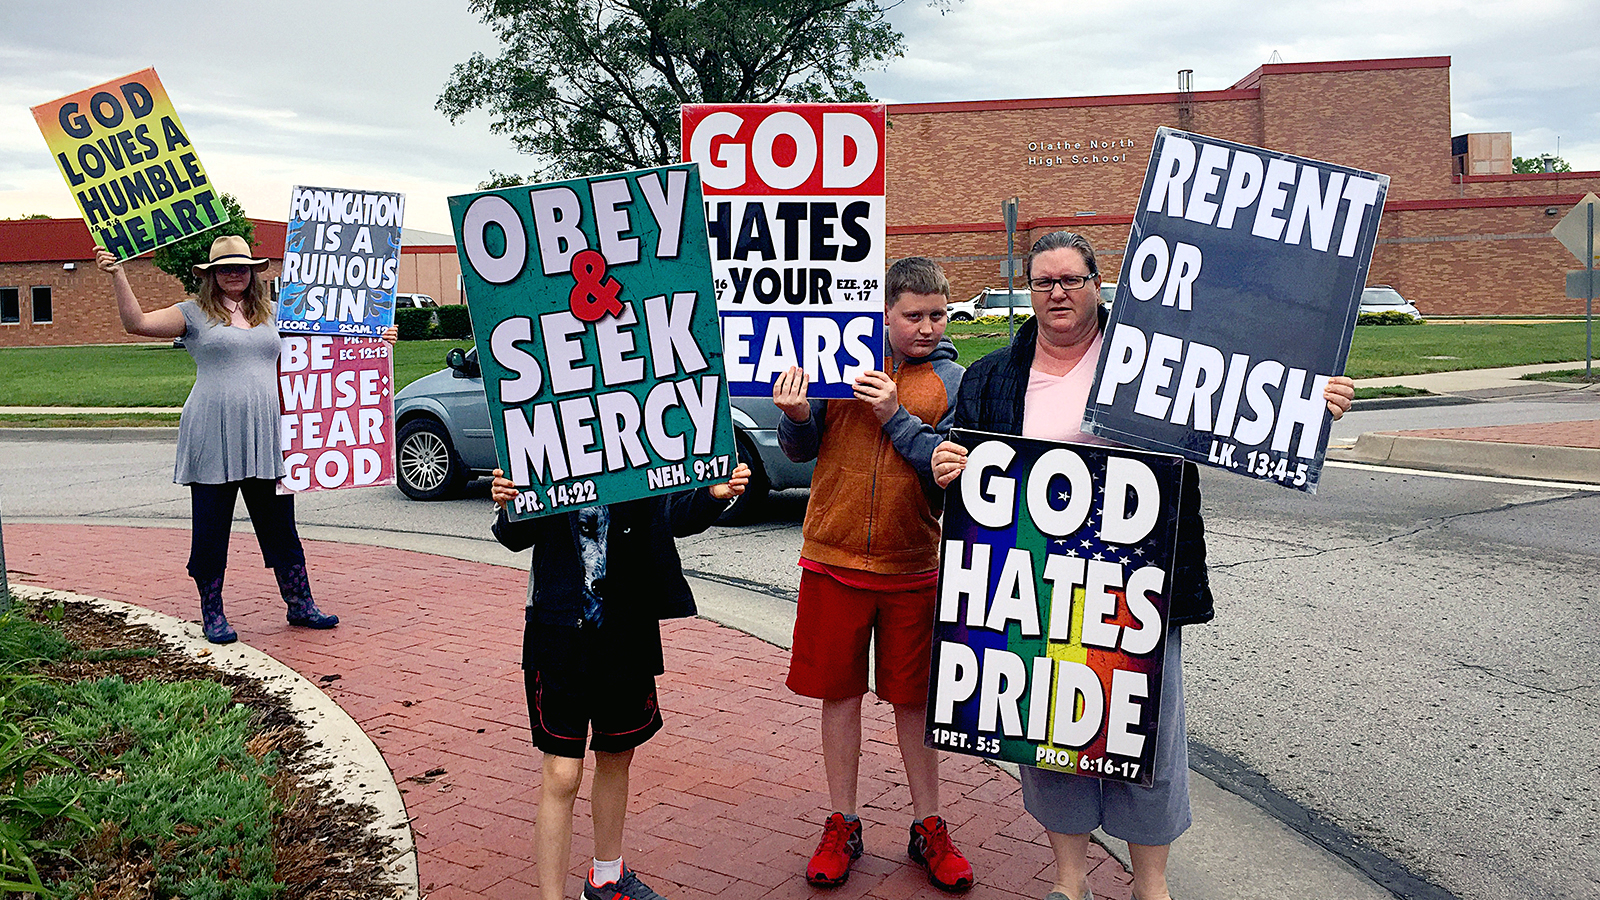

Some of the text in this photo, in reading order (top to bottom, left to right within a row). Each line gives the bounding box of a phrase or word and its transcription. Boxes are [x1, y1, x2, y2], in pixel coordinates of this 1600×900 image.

[58, 82, 154, 139] GOD
[58, 115, 190, 186] LOVES A
[689, 111, 878, 190] GOD
[1028, 139, 1134, 151] Olathe North
[1028, 153, 1126, 167] High School
[77, 152, 207, 225] HUMBLE
[291, 189, 404, 227] FORNICATION
[1147, 135, 1380, 258] REPENT
[100, 190, 221, 261] HEART
[314, 223, 374, 254] IS A
[463, 170, 688, 284] OBEY
[705, 201, 871, 262] HATES
[283, 252, 398, 290] RUINOUS
[570, 250, 624, 321] &
[714, 279, 728, 289] 16
[728, 267, 833, 305] YOUR
[836, 279, 878, 290] EZE. 24
[1129, 235, 1203, 311] OR
[305, 286, 366, 323] SIN
[857, 290, 871, 301] 17
[277, 320, 321, 331] 1COR. 6
[339, 324, 372, 335] 2SAM.
[281, 336, 335, 373] BE
[339, 347, 388, 361] EC. 12:13
[490, 292, 708, 403] SEEK
[719, 316, 875, 385] EARS
[280, 369, 389, 411] WISE:
[1096, 322, 1332, 460] PERISH
[281, 408, 385, 451] FEAR
[503, 375, 719, 487] MERCY
[281, 448, 382, 491] GOD
[647, 454, 730, 490] NEH. 9:17
[1208, 440, 1309, 487] LK. 13:4-5
[514, 480, 597, 514] PR. 14:22
[961, 440, 1160, 544] GOD
[940, 540, 1166, 655] HATES
[934, 641, 1149, 758] PRIDE
[932, 728, 1000, 754] 1PET. 5:5
[1036, 746, 1140, 779] PRO. 6:16-17
